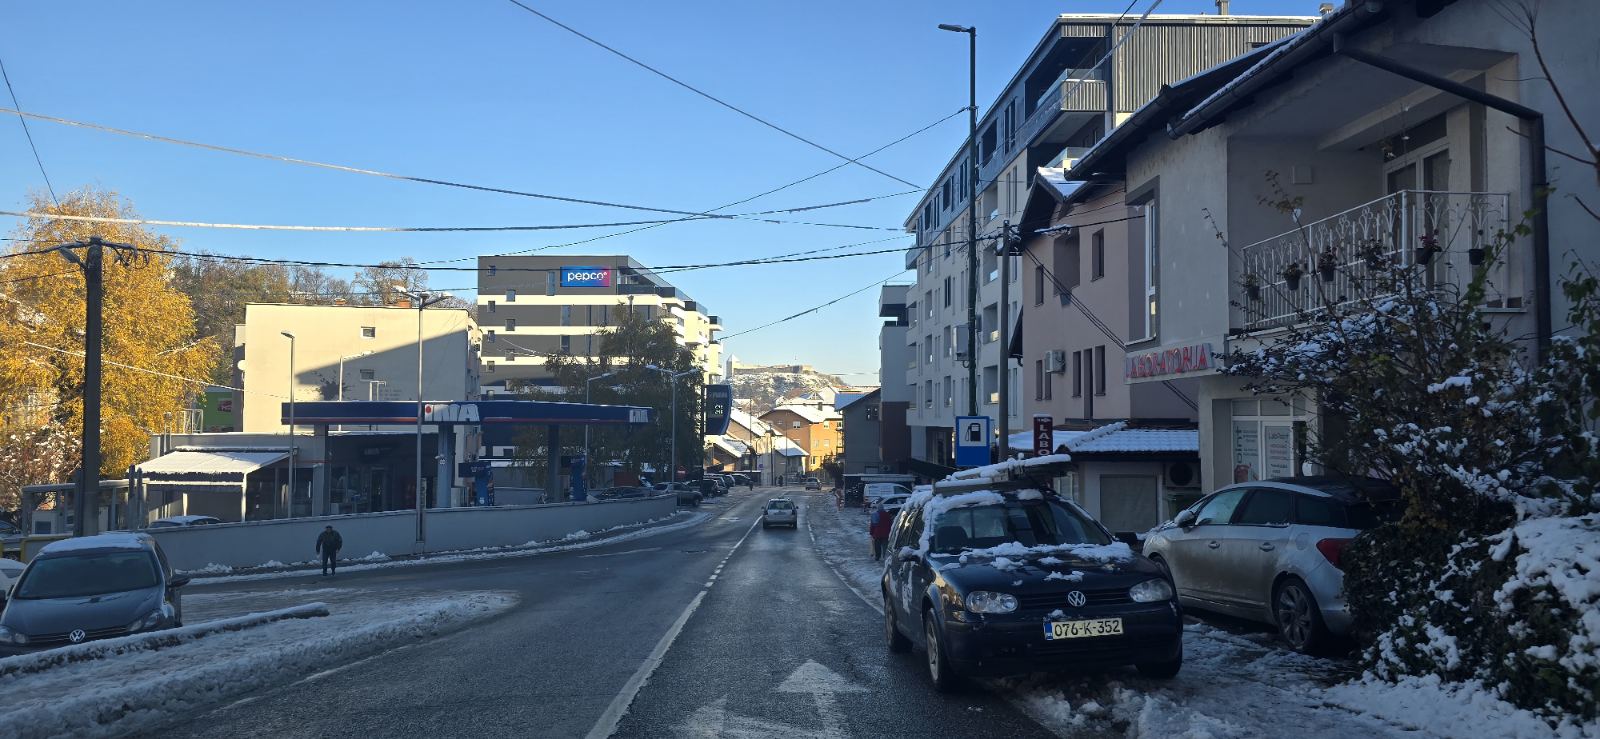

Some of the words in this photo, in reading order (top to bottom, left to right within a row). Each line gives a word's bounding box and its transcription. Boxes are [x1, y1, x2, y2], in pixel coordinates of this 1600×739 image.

[1125, 345, 1208, 379] LABORATORIJA
[424, 404, 480, 422] INA
[1054, 619, 1121, 637] 076-K-352
